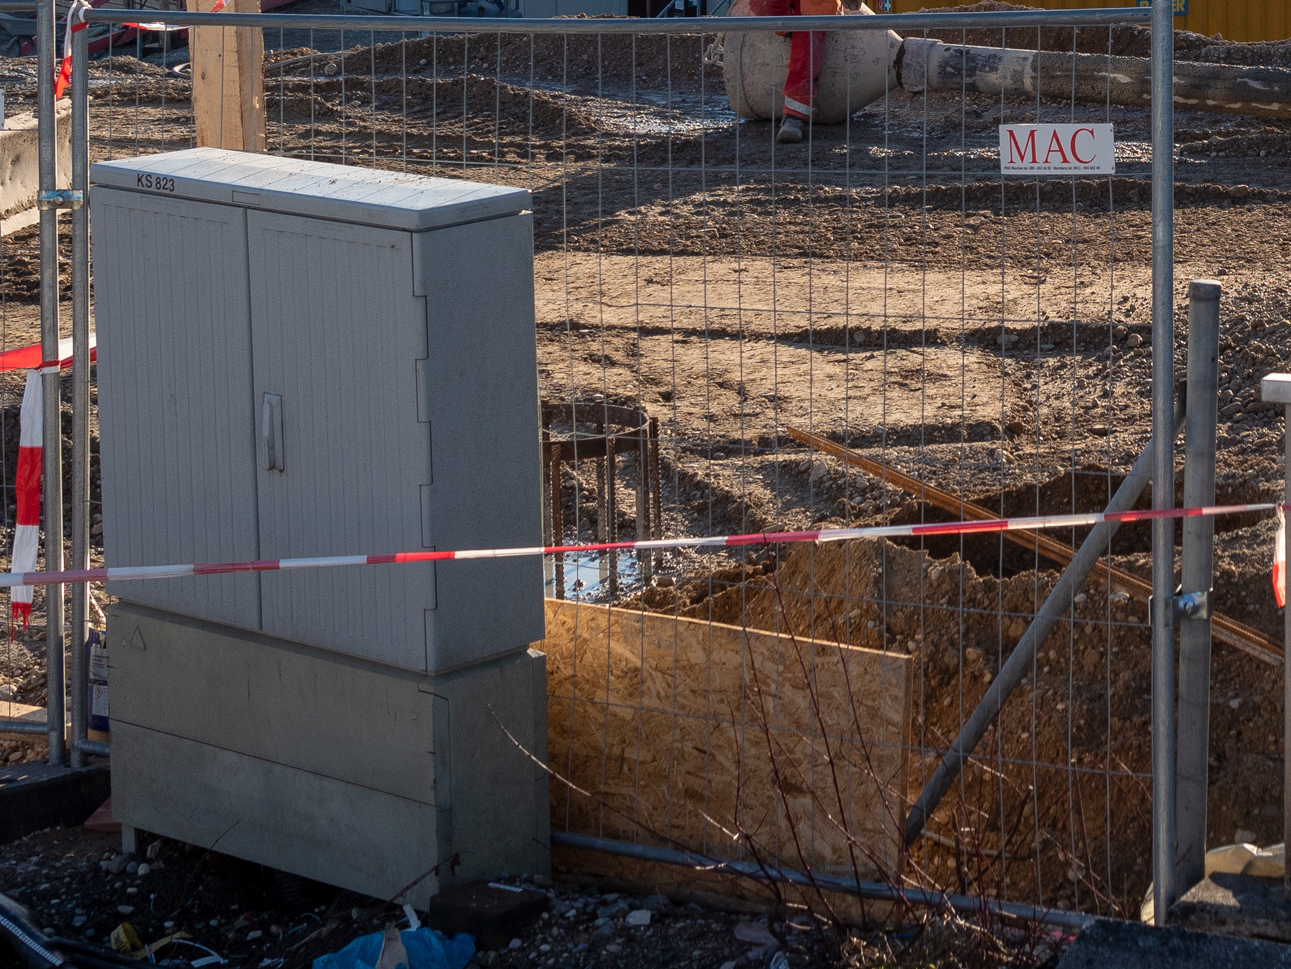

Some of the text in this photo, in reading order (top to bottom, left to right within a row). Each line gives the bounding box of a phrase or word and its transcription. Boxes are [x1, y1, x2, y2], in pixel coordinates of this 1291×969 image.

[1006, 128, 1097, 164] MAC
[137, 173, 175, 192] KS 823
